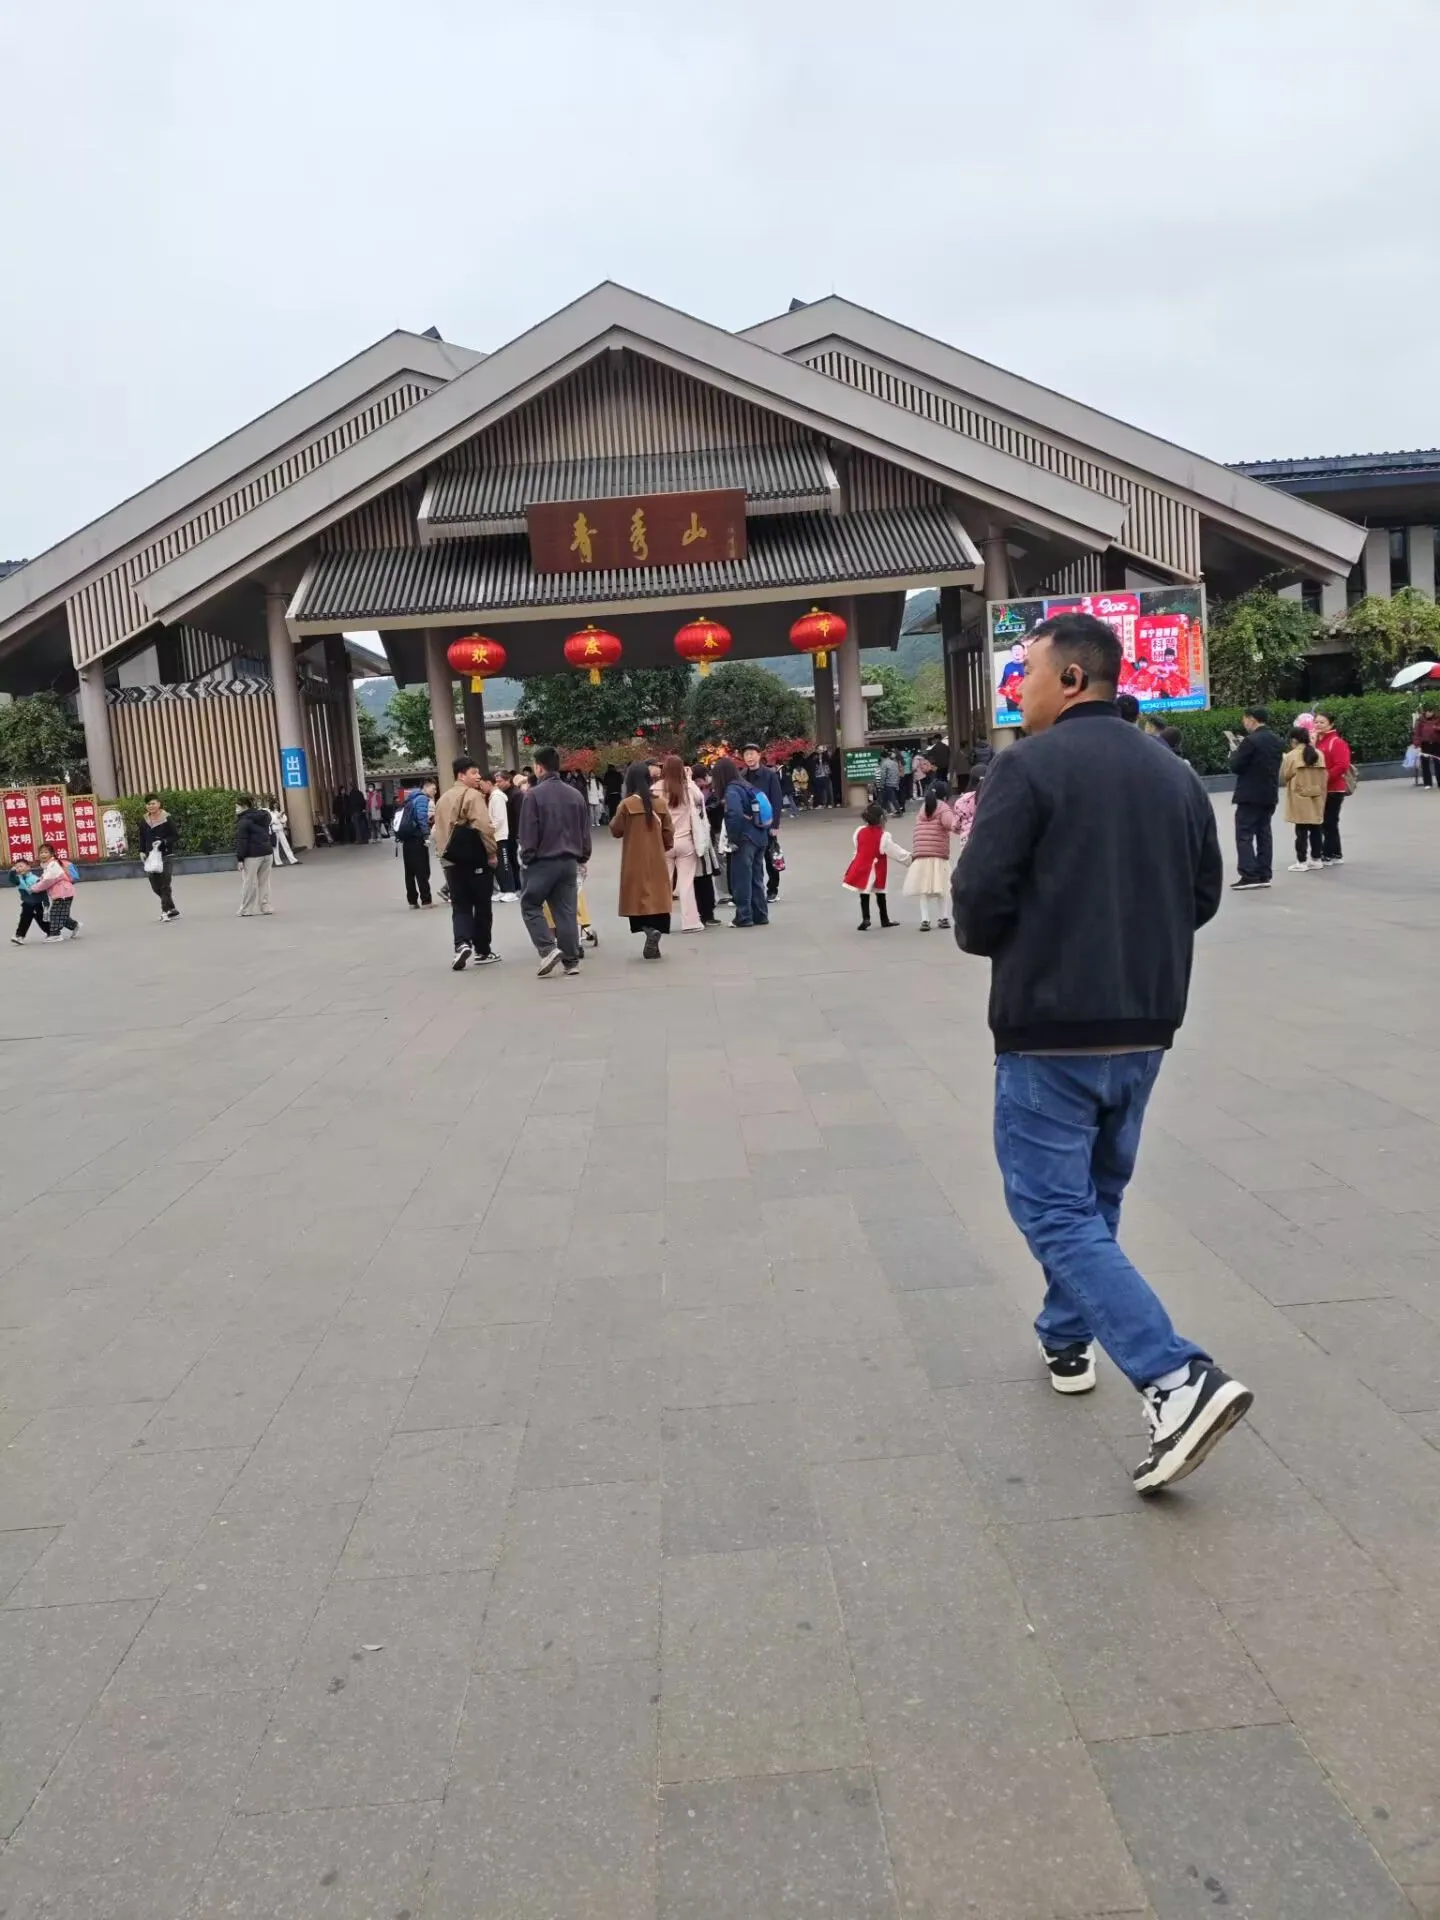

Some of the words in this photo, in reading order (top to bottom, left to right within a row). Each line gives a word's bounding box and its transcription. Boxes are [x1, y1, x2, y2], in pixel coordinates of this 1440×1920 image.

[471, 644, 489, 664] 欢
[703, 630, 719, 648] 春
[286, 755, 302, 786] 出口
[5, 798, 27, 809] 富强
[40, 795, 61, 806] 自由
[75, 806, 94, 816] 爱国
[8, 816, 29, 827] 民主
[42, 813, 63, 824] 平等
[76, 819, 96, 829] 敬业
[10, 834, 31, 845] 文明
[45, 831, 66, 841] 公正
[77, 833, 97, 842] 诚信
[80, 845, 98, 855] 友善
[12, 852, 33, 862] 和谐
